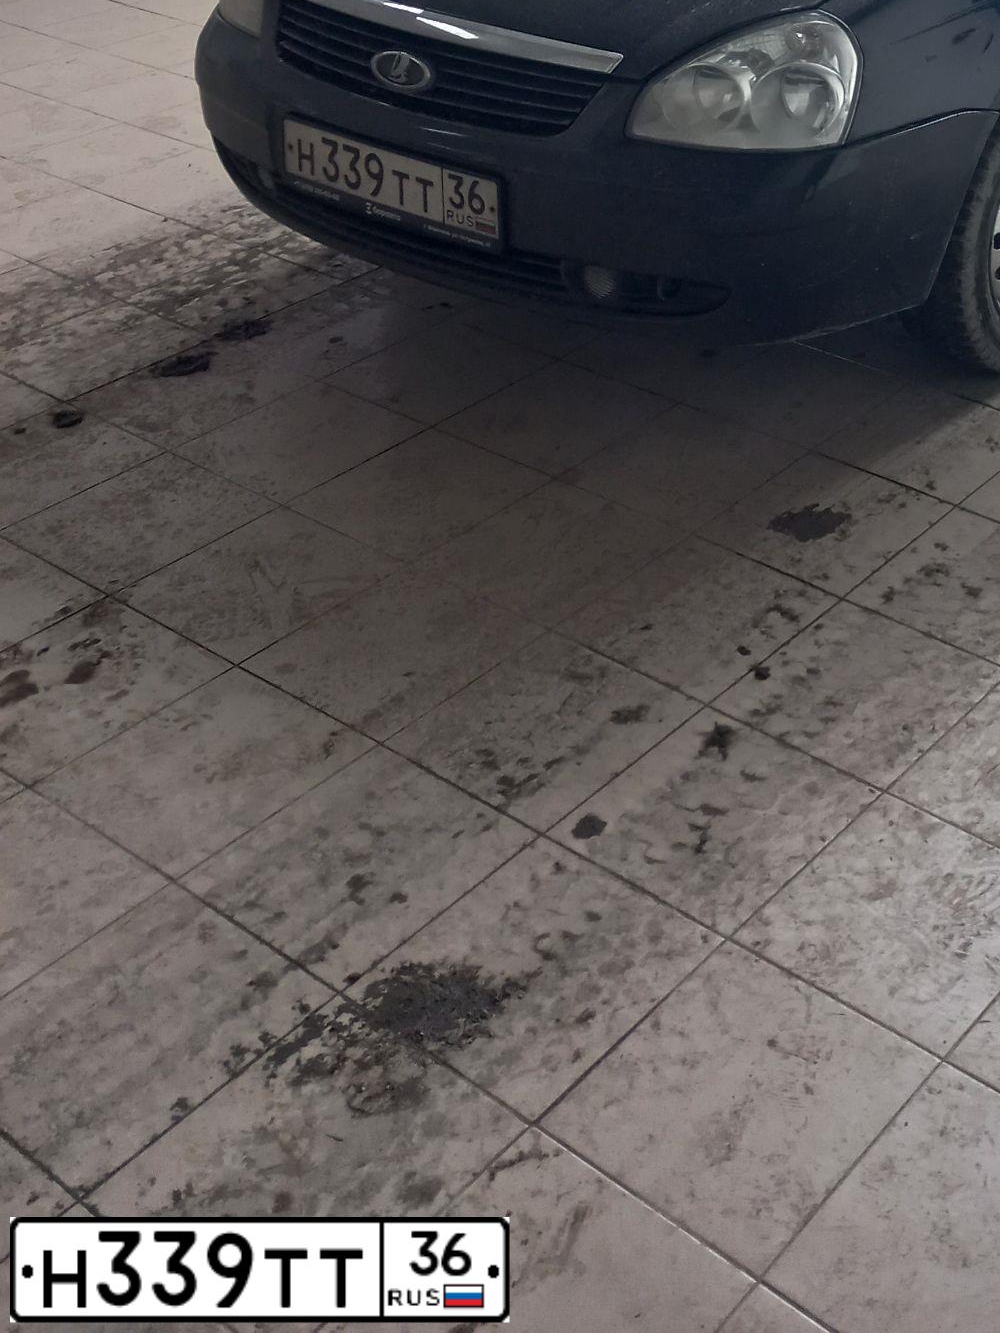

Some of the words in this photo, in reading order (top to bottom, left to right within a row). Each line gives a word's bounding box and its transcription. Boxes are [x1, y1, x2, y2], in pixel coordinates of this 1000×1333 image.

[297, 136, 434, 214] Н339ТТ
[448, 174, 486, 215] 36
[446, 209, 474, 228] RUS
